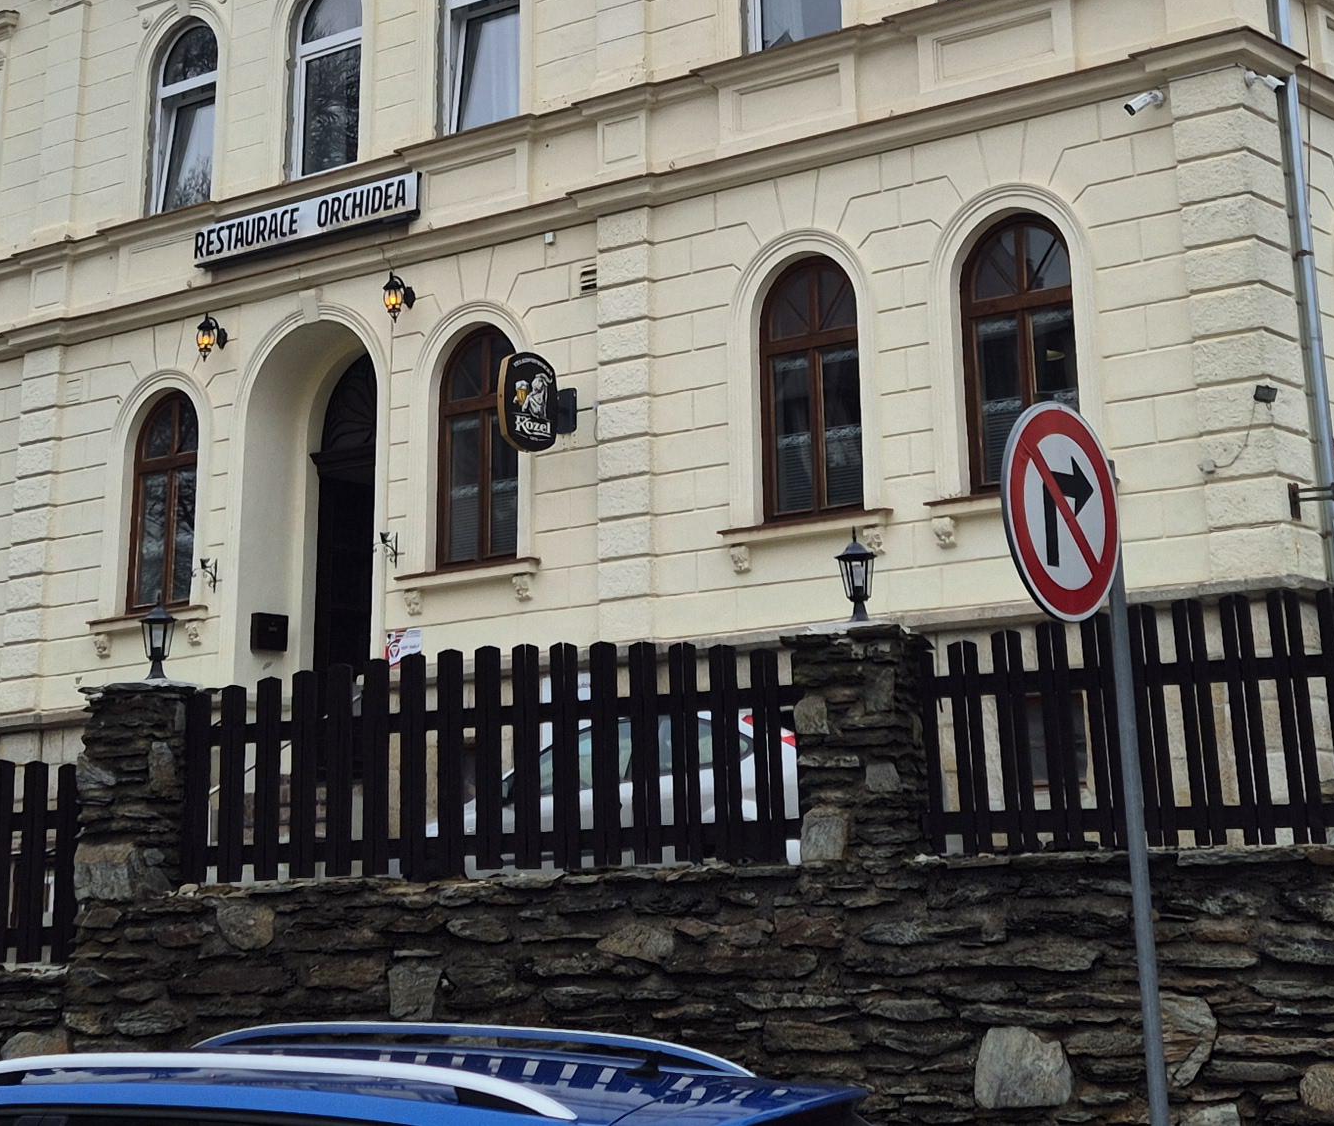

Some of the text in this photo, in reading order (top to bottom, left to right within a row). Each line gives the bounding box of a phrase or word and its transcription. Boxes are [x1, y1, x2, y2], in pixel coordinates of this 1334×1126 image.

[194, 179, 406, 259] RESTAURACE ORCHIDEA
[515, 415, 551, 437] Kozel
